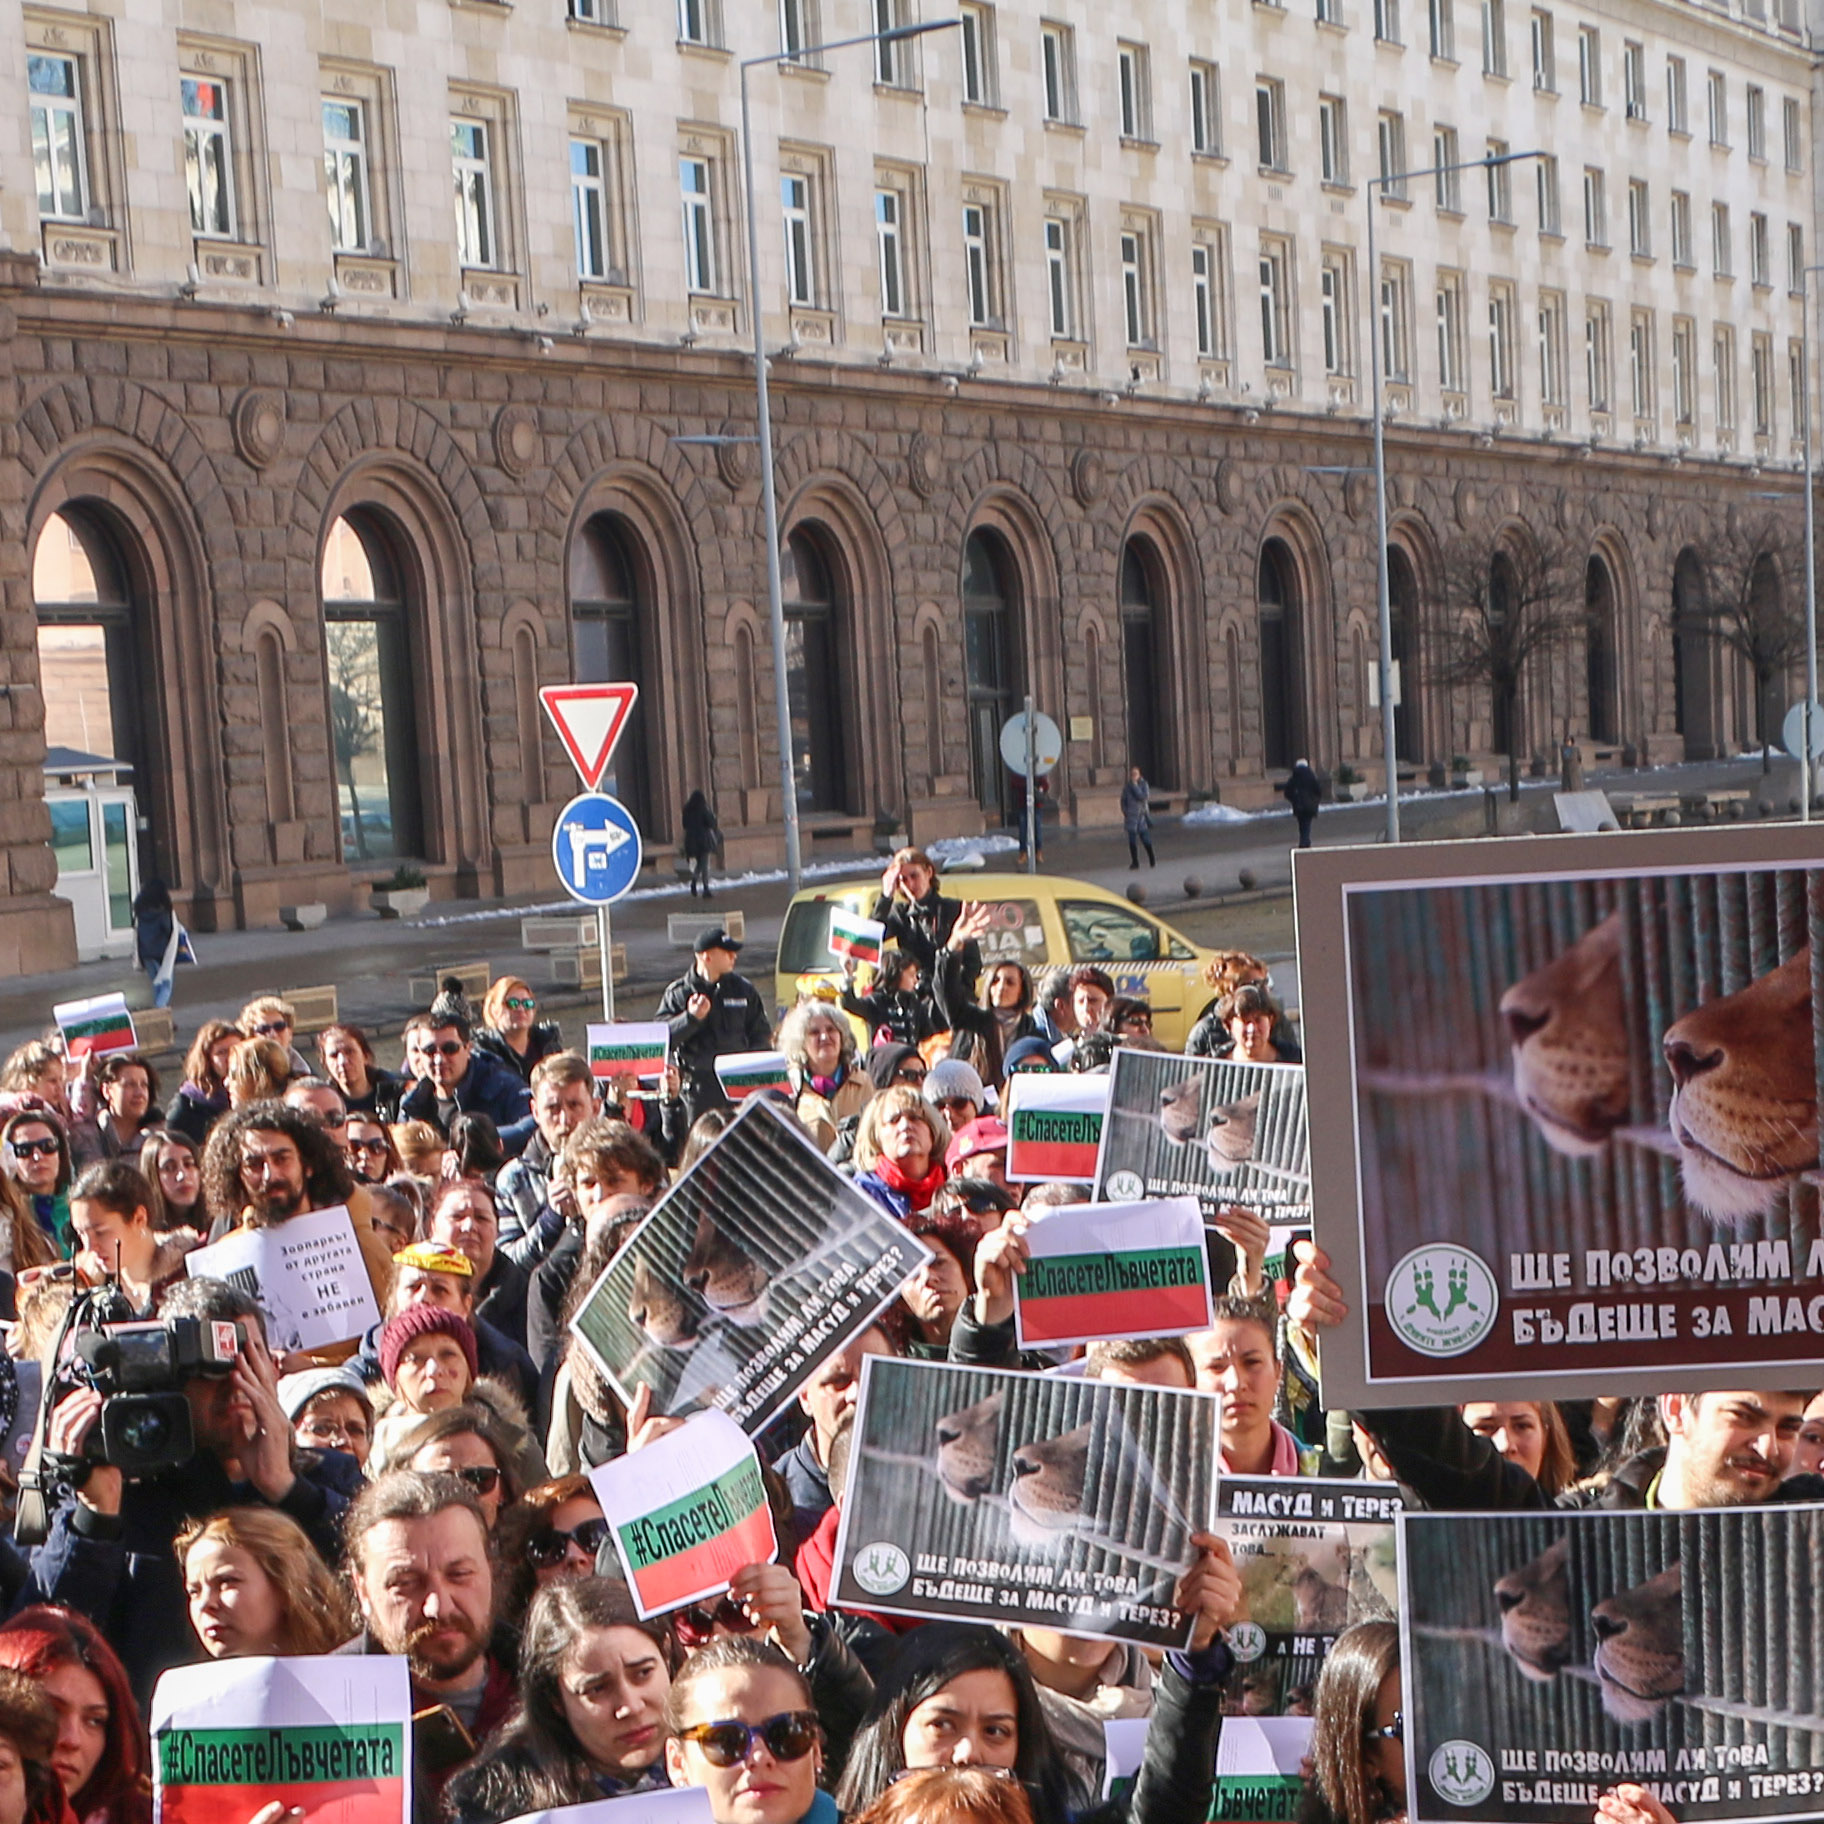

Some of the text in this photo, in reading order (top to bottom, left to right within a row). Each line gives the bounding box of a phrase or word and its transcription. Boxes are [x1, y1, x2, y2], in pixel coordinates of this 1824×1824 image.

[1147, 1177, 1168, 1192] ЩЕ
[1170, 1179, 1237, 1200] ПОЗВОЛИМ
[1239, 1188, 1260, 1201] ЛИ
[280, 1232, 348, 1257] Зоопаркът
[285, 1248, 353, 1271] от другата
[301, 1265, 345, 1281] страна
[1025, 1256, 1199, 1298] #СпасетеЛъвчетата
[1510, 1252, 1573, 1290] ЩЕ
[1585, 1239, 1791, 1287] ПОЗВОЛИМ
[316, 1282, 341, 1299] НЕ
[313, 1297, 365, 1318] забавен
[712, 1262, 858, 1410] ЩЕ ПОЗВОЛИМ ЛИ ТОВА
[730, 1366, 788, 1425] БЪДЕЩЕ
[798, 1301, 851, 1355] МАСУД
[855, 1246, 903, 1294] ТЕРЕЗ?
[1512, 1307, 1677, 1347] БЪДЕЩЕ
[1231, 1491, 1404, 1519] МАСУД ТЕРЕЗ
[1230, 1524, 1327, 1540] ЗАСЛУЖАВАТ
[917, 1554, 1137, 1594] ЩЕ ПОЗВОЛИМ ЛИ ТОВА
[912, 1579, 994, 1604] БЪДЕЩЕ
[1026, 1590, 1093, 1615] МАСУД
[1118, 1601, 1181, 1630] ТЕРЕЗ?
[1292, 1636, 1318, 1657] НЕ
[166, 1729, 395, 1781] #СпасетеЛъвчетата
[1500, 1742, 1768, 1773] ЩЕ ПОЗВОЛИМ ЛИ ТОВА
[1503, 1778, 1600, 1804] БЪДЕЩЕ
[1649, 1778, 1721, 1803] МАСУД
[1749, 1772, 1824, 1799] ТЕРЕЗ?
